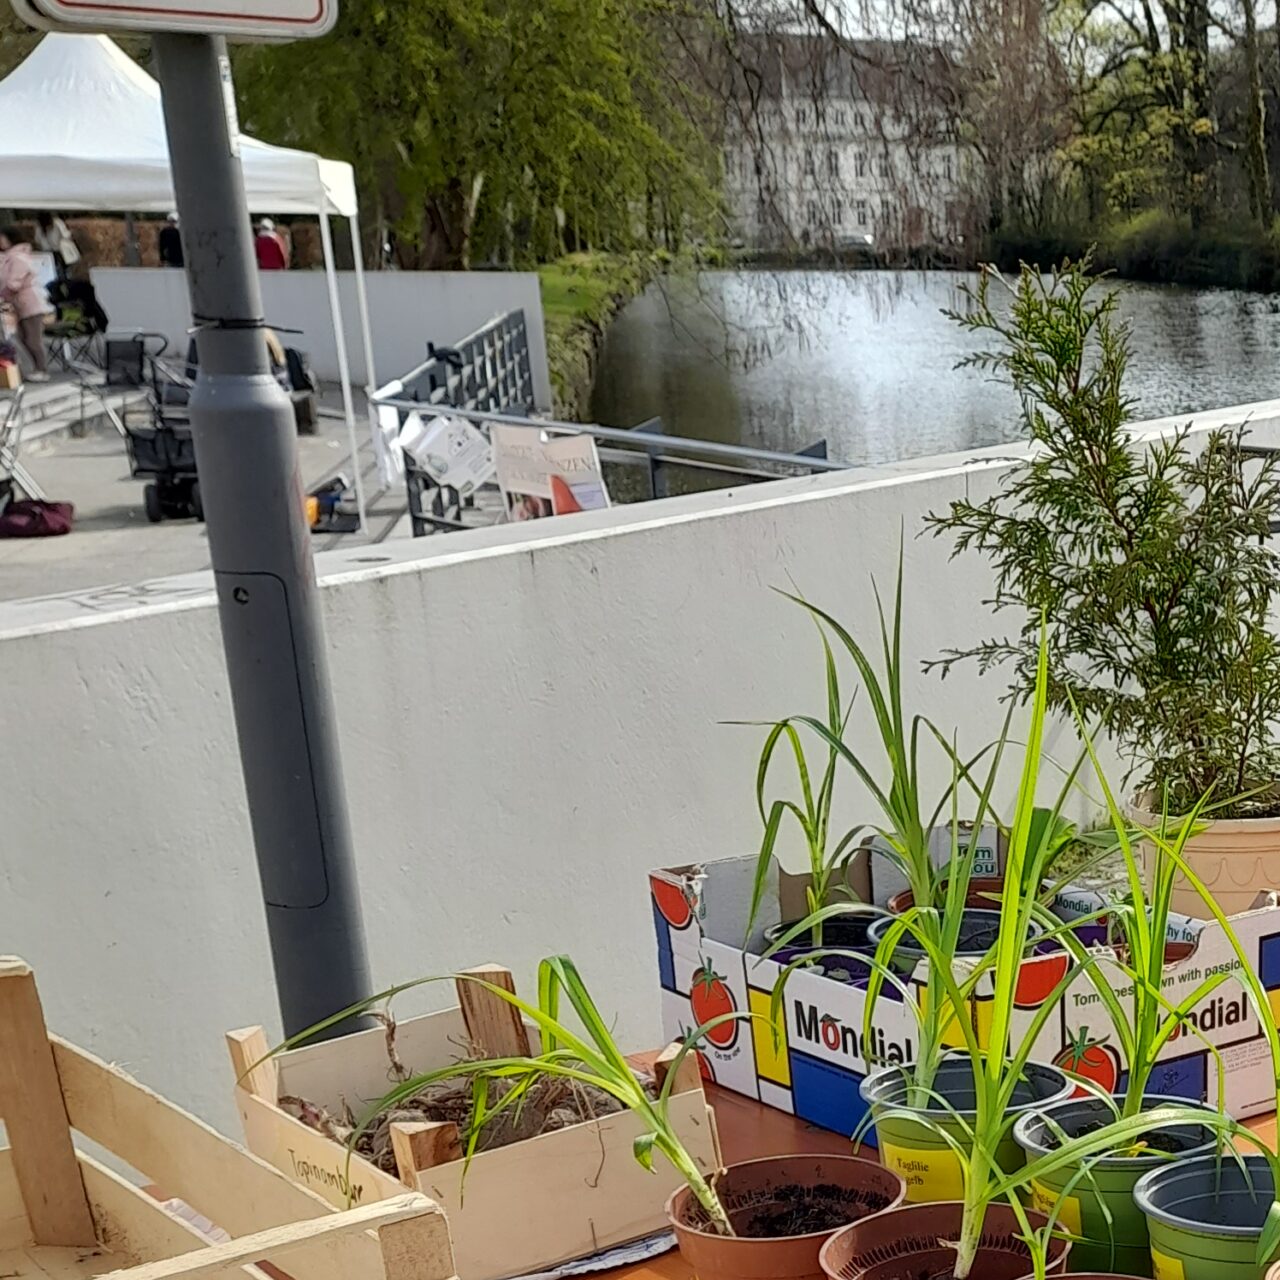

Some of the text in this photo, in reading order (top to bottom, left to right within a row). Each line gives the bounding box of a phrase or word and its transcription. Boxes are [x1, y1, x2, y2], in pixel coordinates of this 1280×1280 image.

[1054, 894, 1092, 914] Mondial
[794, 999, 913, 1068] Mondial
[897, 1158, 929, 1172] Taglilie
